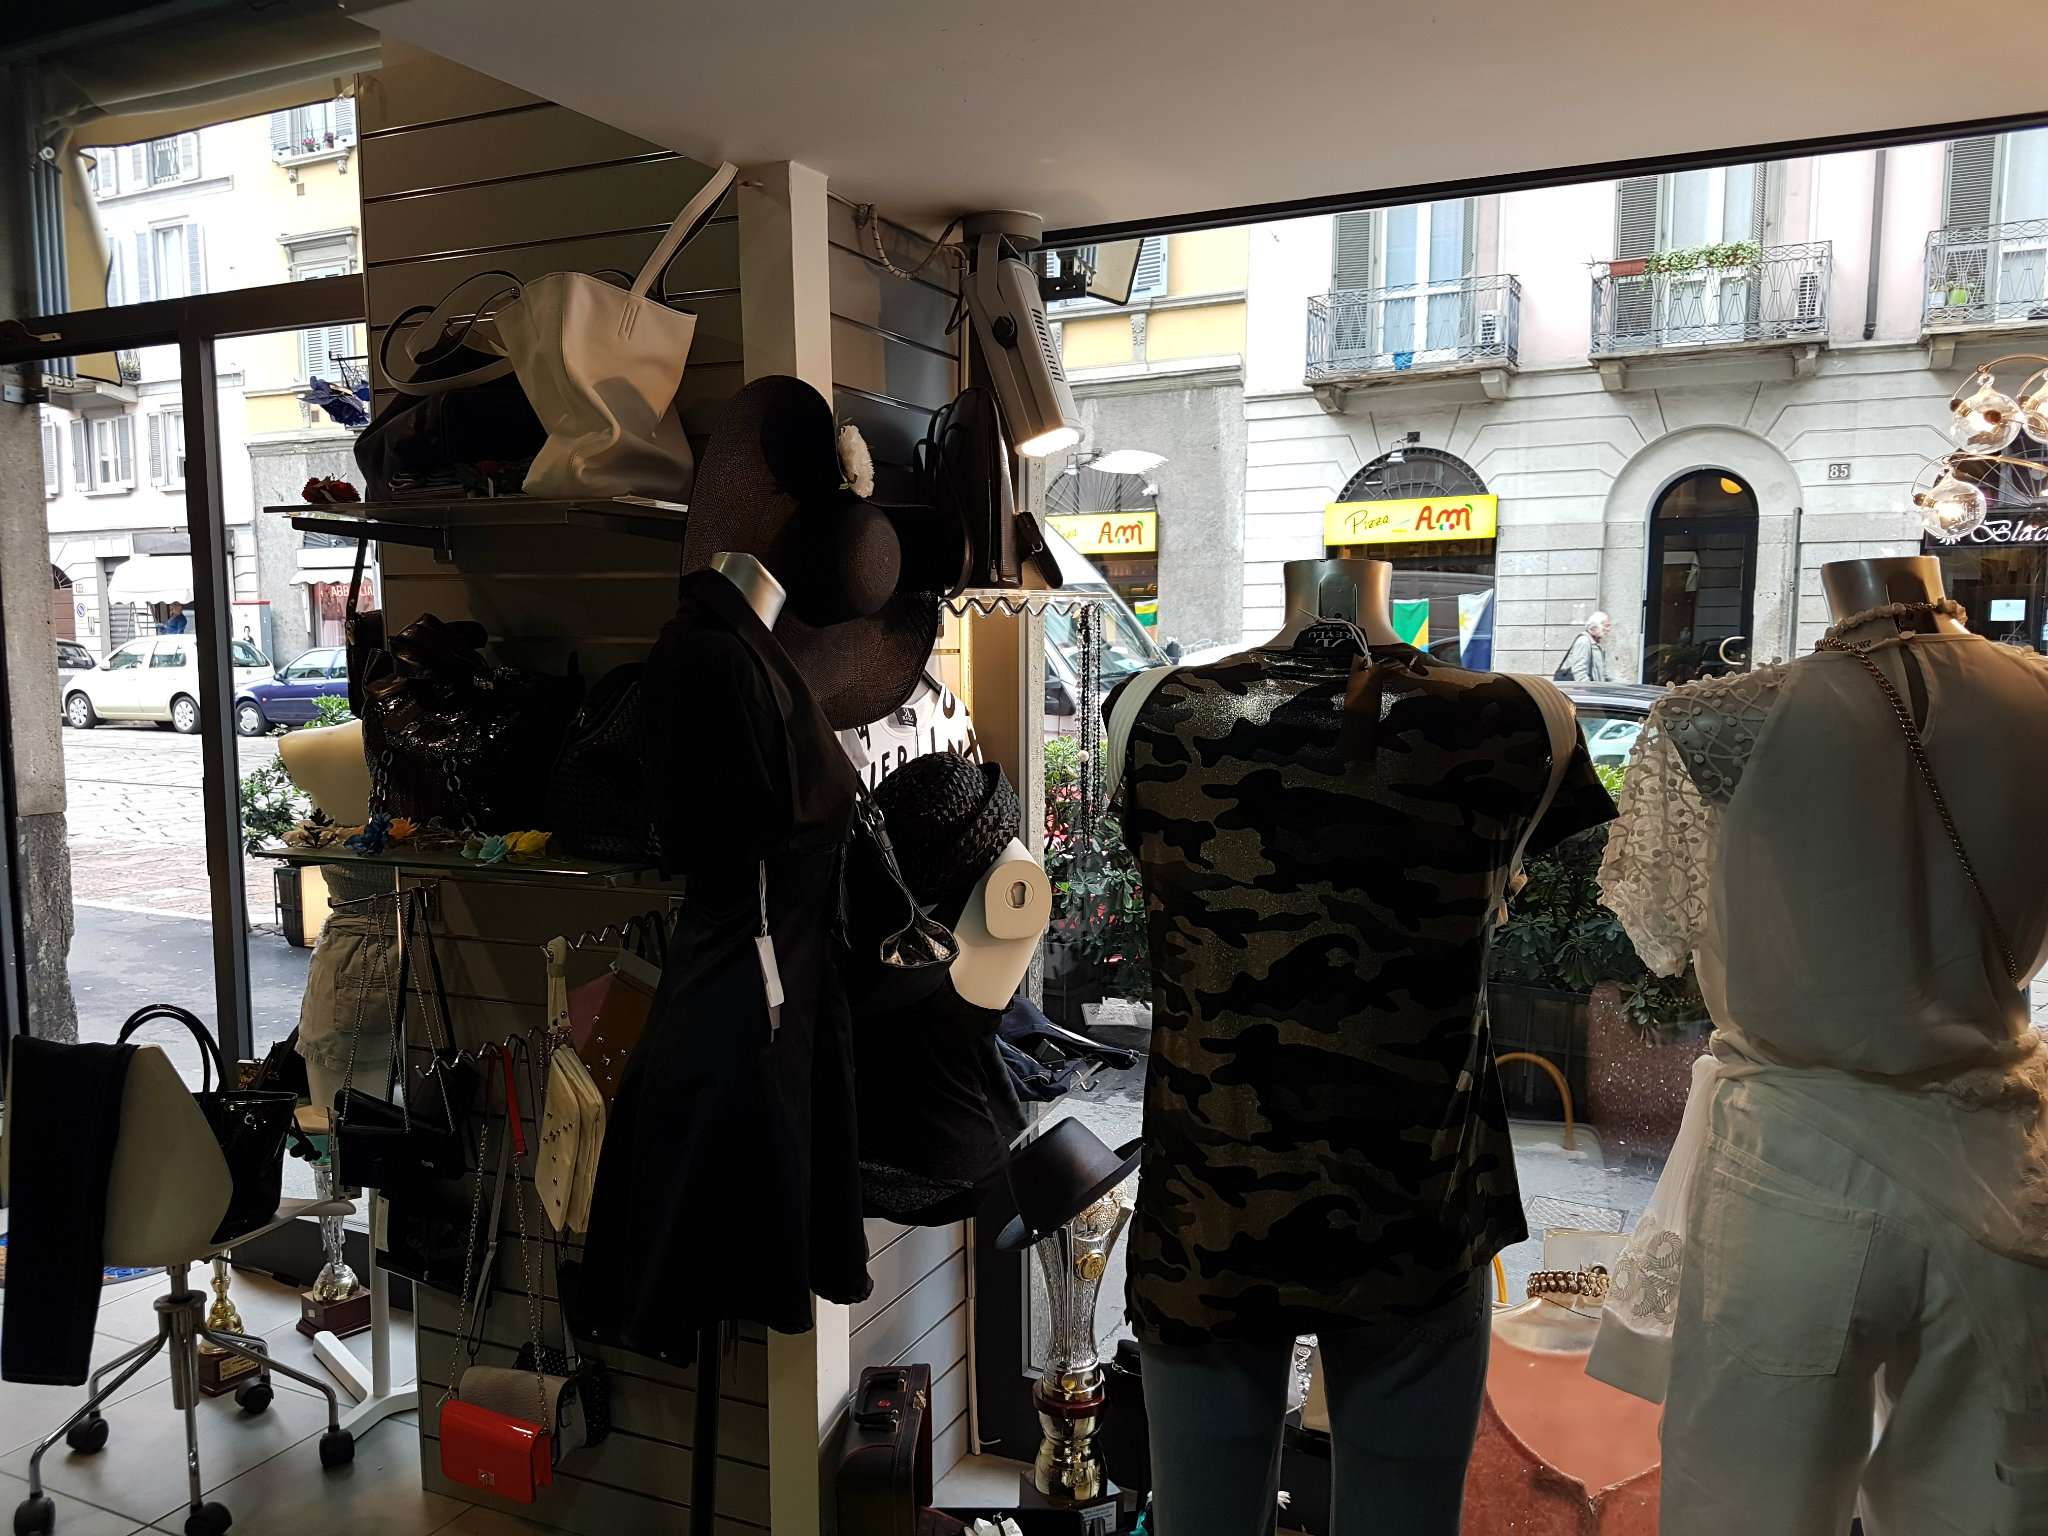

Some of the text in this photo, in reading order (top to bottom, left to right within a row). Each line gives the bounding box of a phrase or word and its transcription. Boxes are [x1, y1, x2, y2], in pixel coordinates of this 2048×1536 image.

[1829, 464, 1849, 478] 85
[1345, 510, 1389, 534] Pizza
[1970, 519, 2048, 543] Blac
